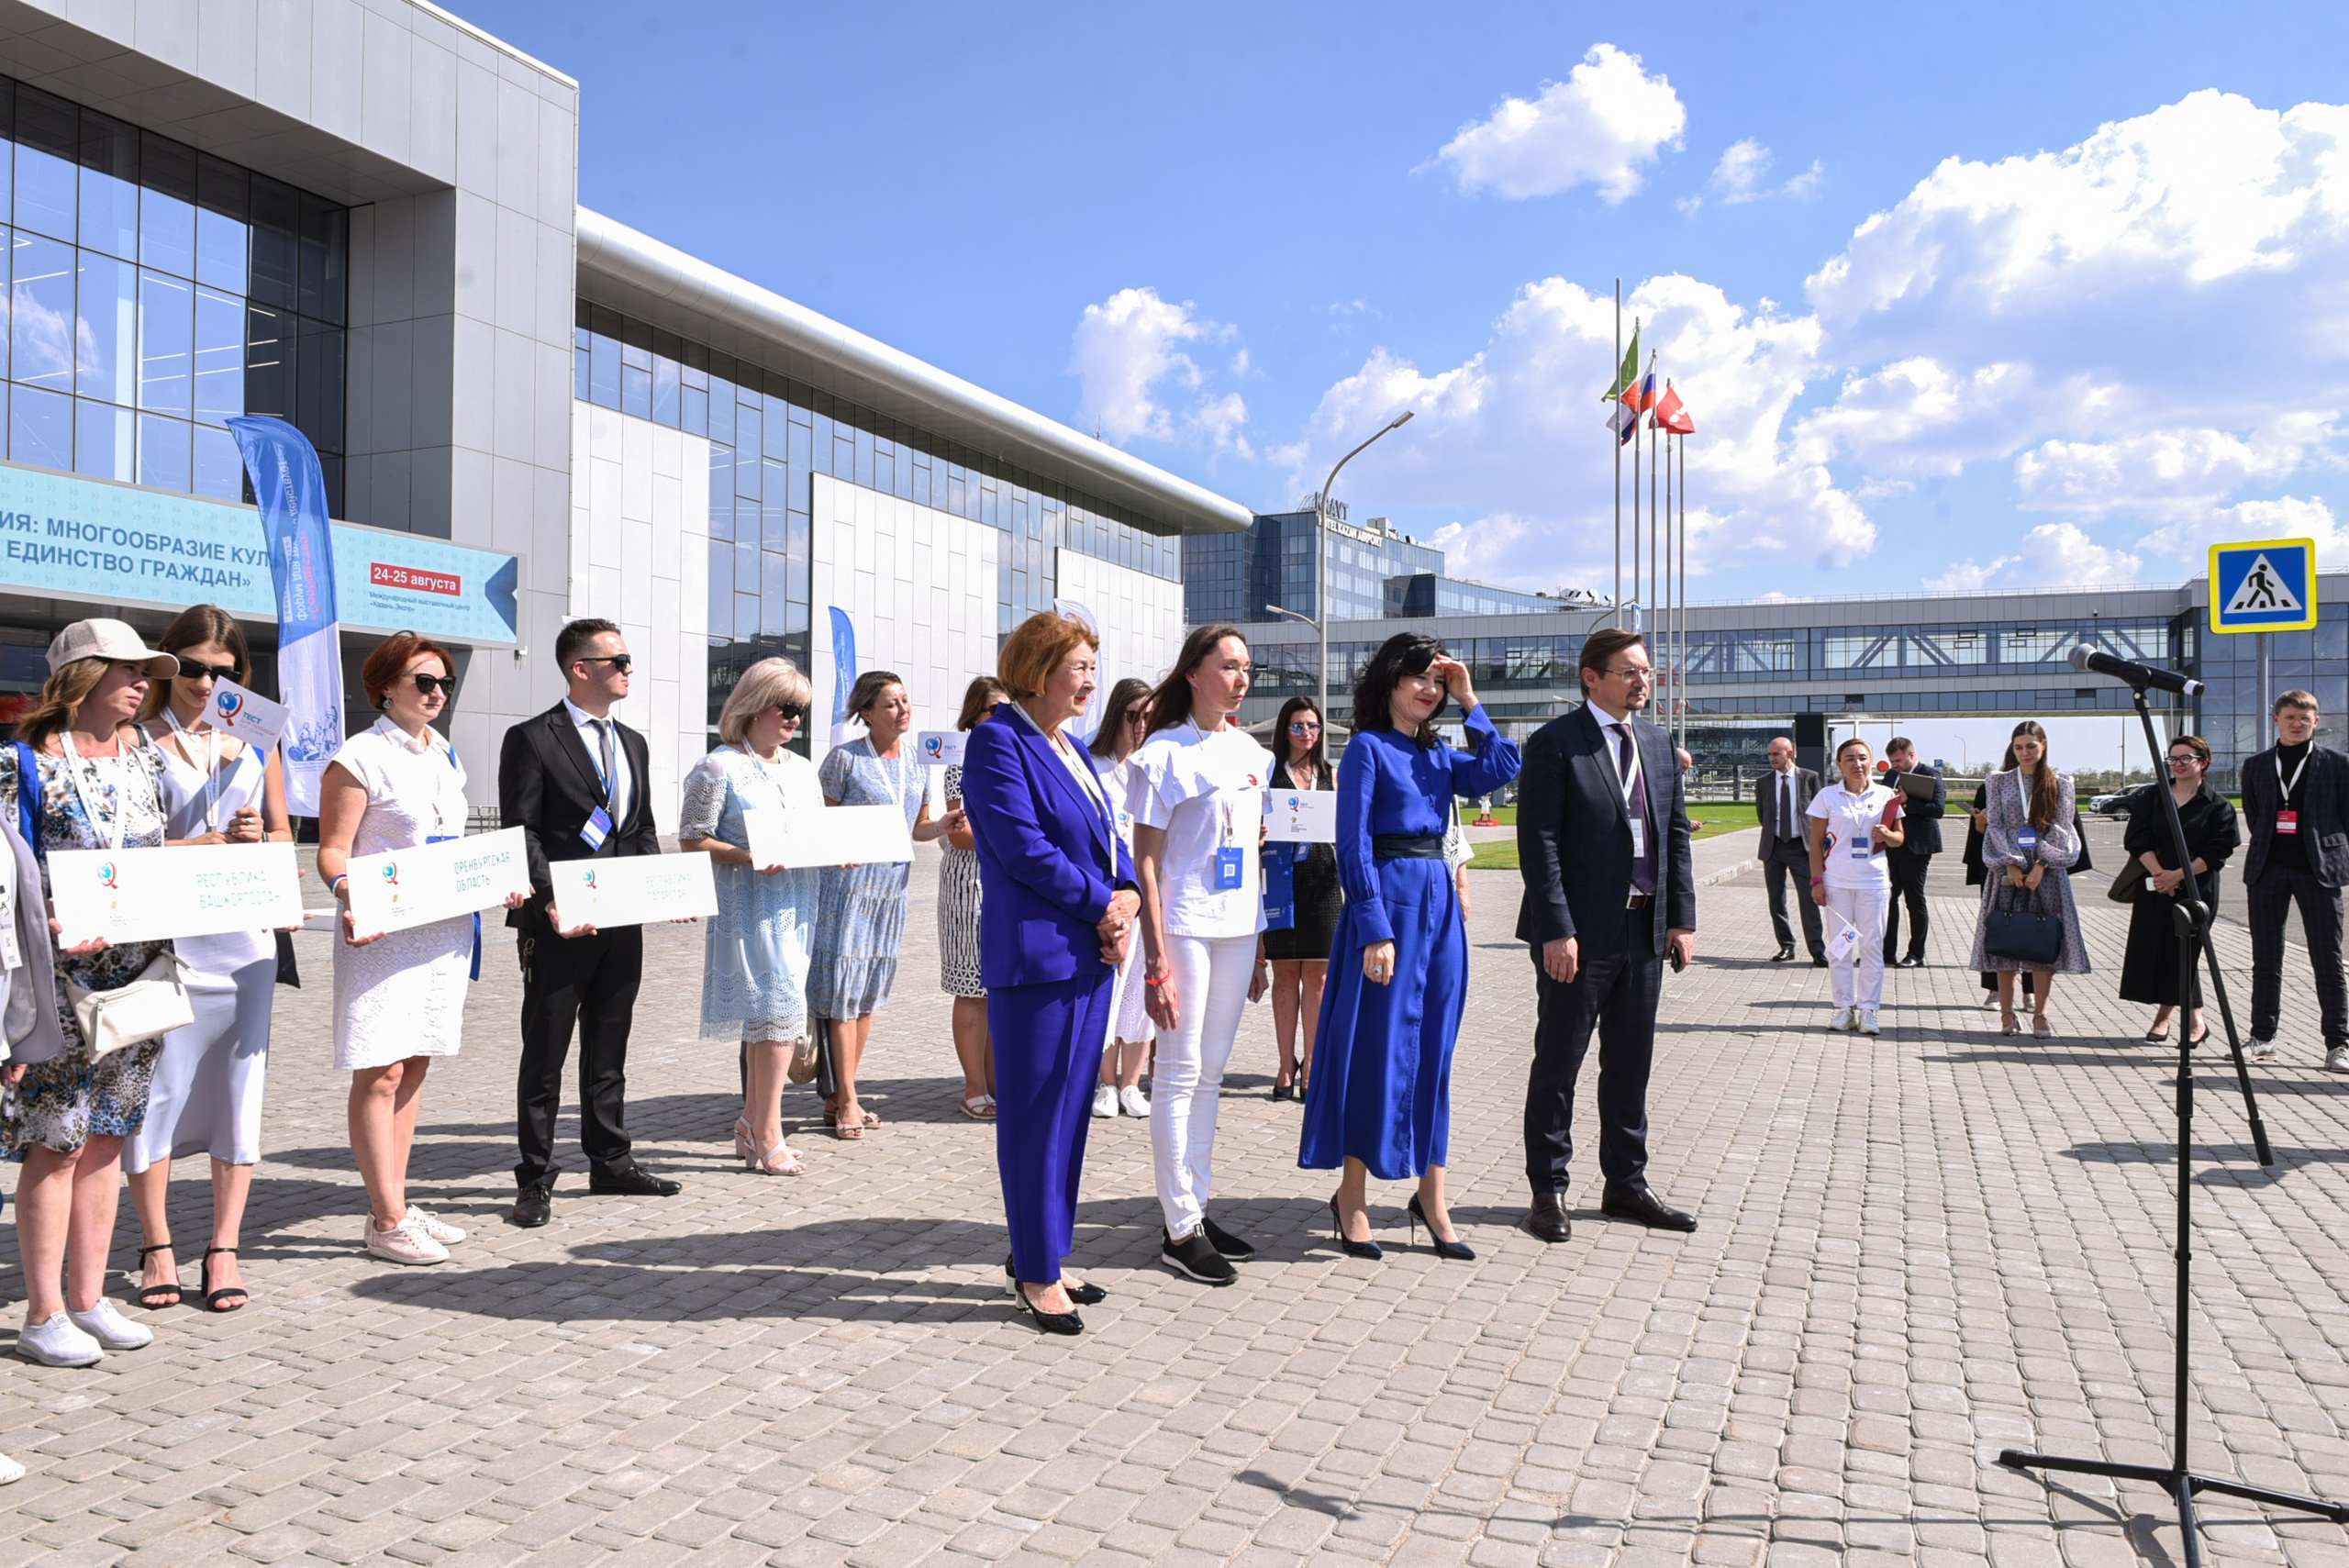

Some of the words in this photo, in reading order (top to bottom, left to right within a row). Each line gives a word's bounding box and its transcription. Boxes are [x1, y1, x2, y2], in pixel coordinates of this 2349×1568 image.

[47, 517, 226, 561] МНОГООБРАЗИЕ
[7, 539, 134, 574] ЕДИНСТВО
[140, 559, 250, 587] ГРАЖДАН»
[373, 567, 407, 584] 24-25
[410, 573, 457, 591] августа
[242, 711, 262, 725] ТЕСТ
[454, 851, 510, 874] ОРЕНБУРГСКАЯ
[456, 874, 491, 893] ОБЛАСТЬ
